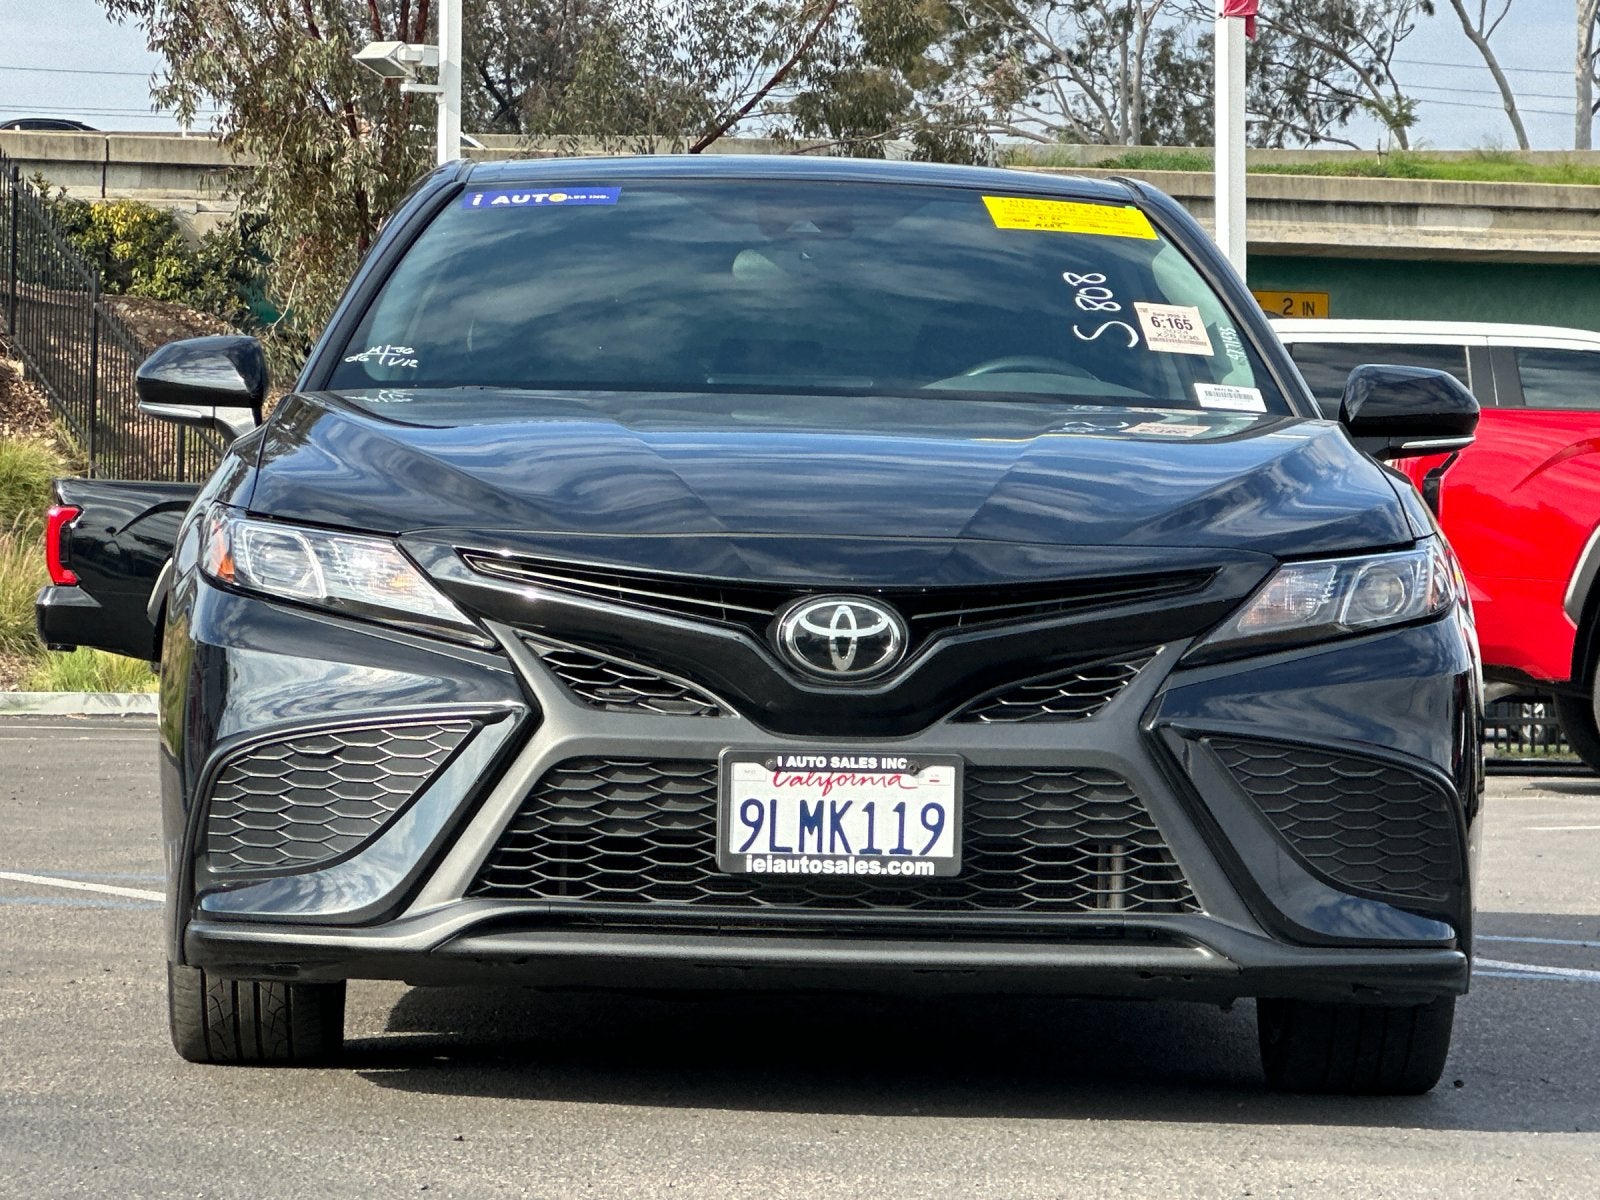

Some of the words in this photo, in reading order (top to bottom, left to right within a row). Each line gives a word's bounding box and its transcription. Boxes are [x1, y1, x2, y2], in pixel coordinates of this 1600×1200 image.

[1282, 298, 1293, 315] 2
[1302, 301, 1315, 316] IN
[1151, 315, 1193, 331] 6:165
[786, 756, 827, 769] AUTO
[830, 757, 878, 769] SALES
[881, 758, 907, 770] INC
[772, 770, 918, 797] California
[739, 798, 945, 856] 9LMK119
[746, 855, 935, 876] ieiautosales.com
